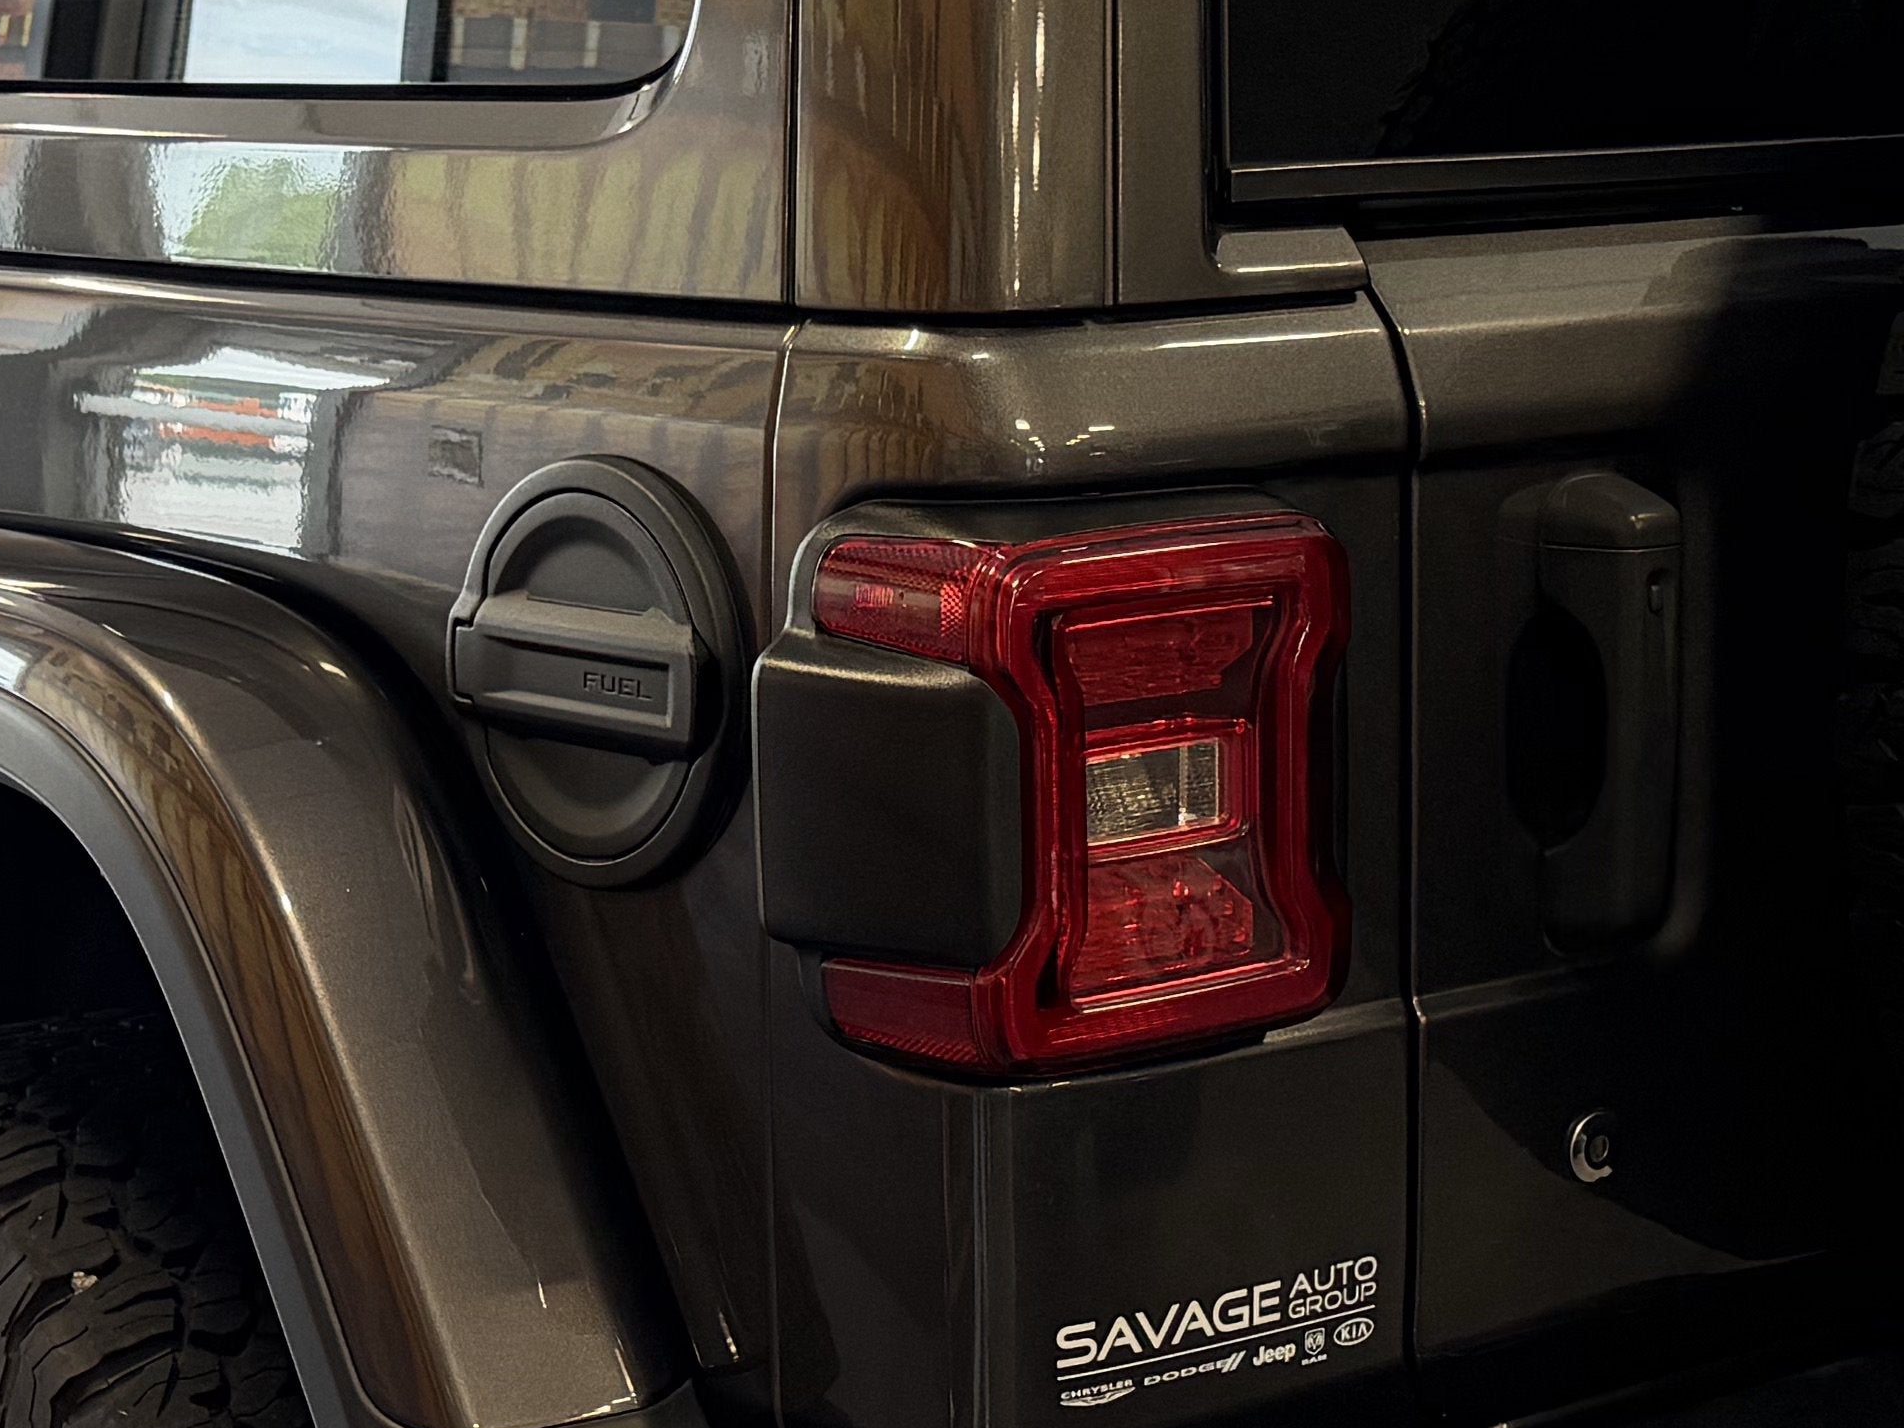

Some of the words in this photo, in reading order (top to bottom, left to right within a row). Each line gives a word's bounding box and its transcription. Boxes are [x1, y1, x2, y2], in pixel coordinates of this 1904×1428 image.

[583, 671, 652, 700] FUEL
[1289, 1255, 1378, 1299] AUTO
[1288, 1281, 1378, 1320] GROUP
[1056, 1279, 1282, 1369] SAVAGE
[1060, 1378, 1134, 1401] CHRYSLER
[1143, 1358, 1232, 1387] DODGE
[1252, 1341, 1296, 1368] Jeep
[1301, 1353, 1328, 1366] RAM
